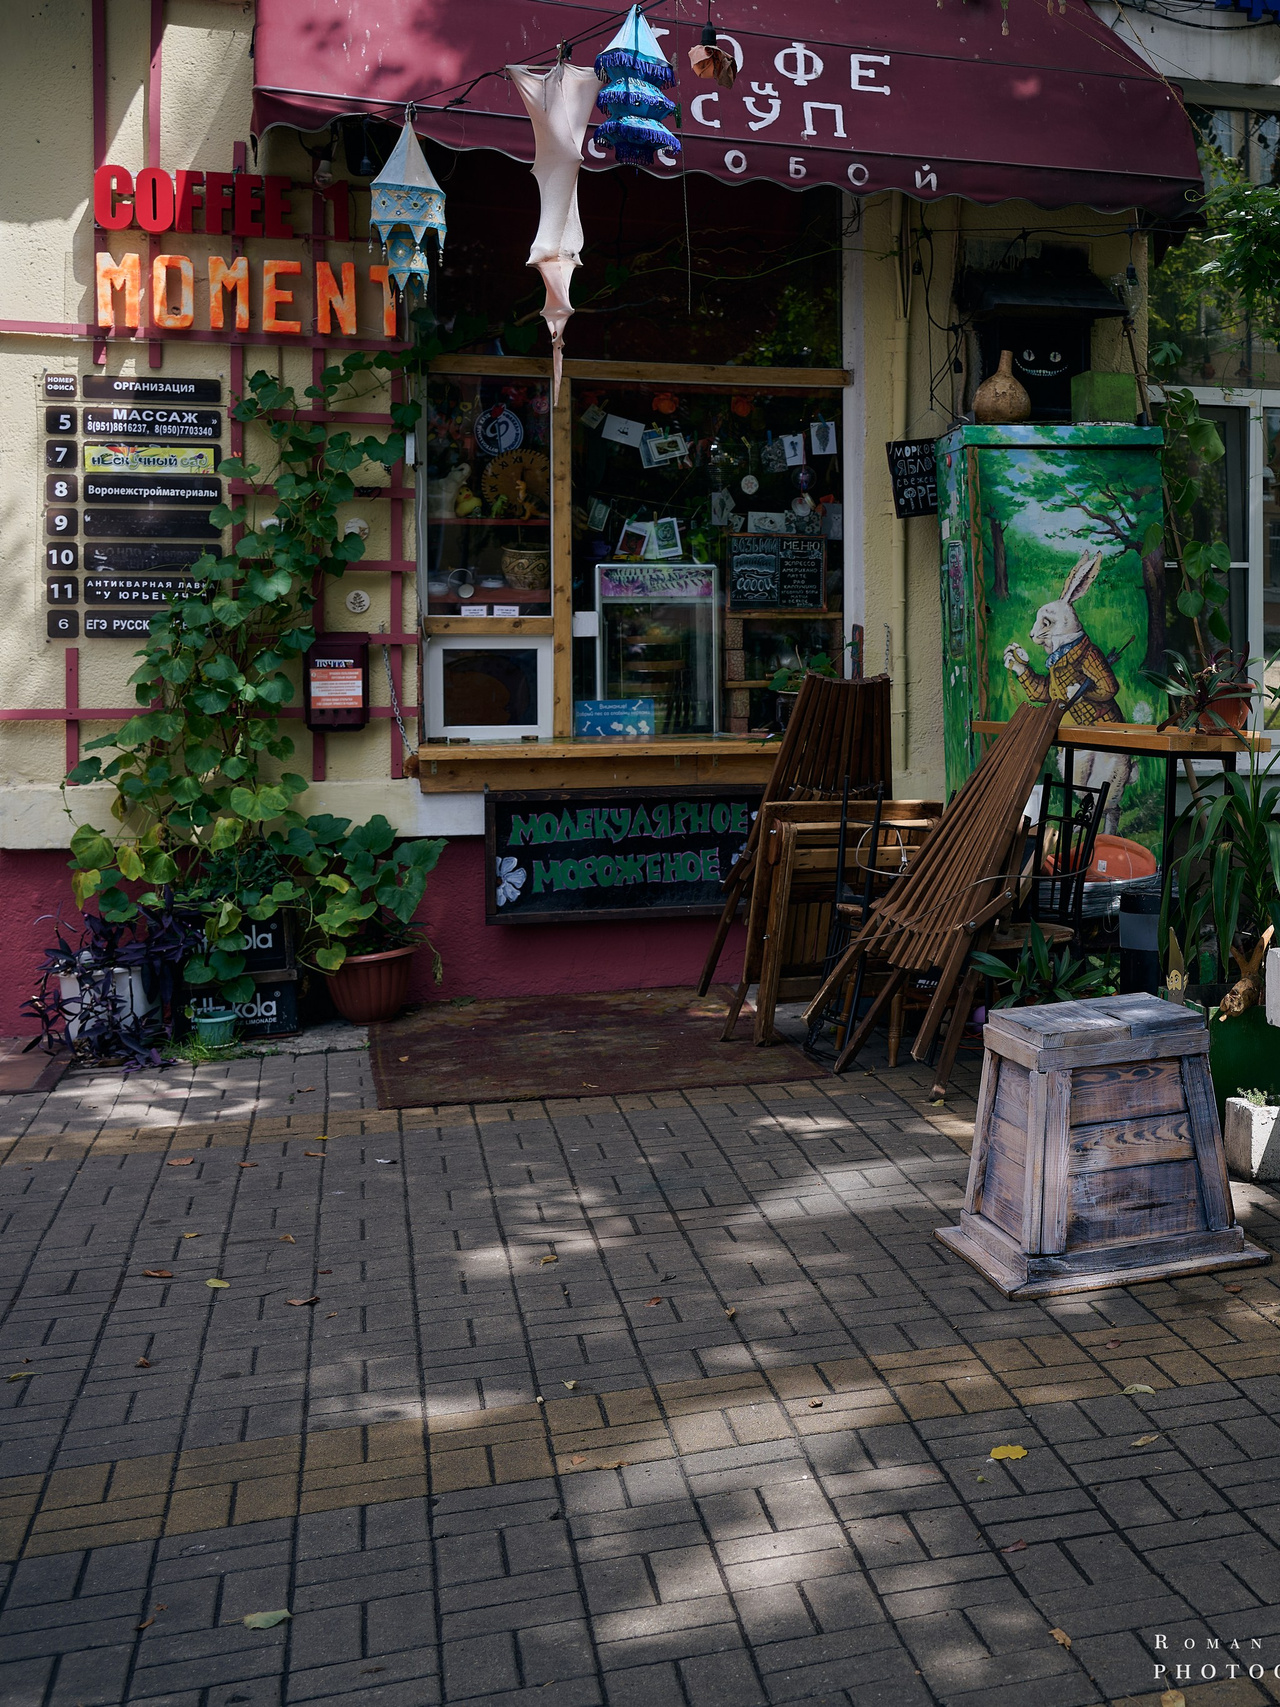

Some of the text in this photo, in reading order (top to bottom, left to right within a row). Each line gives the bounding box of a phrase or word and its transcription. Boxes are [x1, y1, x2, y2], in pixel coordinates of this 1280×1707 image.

[94, 165, 294, 239] COFFEE
[96, 252, 398, 338] MOMENT
[47, 376, 75, 384] НОМЕР
[113, 381, 196, 394] ОРГАНИЗАЦИЯ
[59, 414, 72, 431] 5
[112, 409, 199, 424] МАССАЖ
[87, 421, 213, 437] 8(951)8616237, 8(950)7703340
[55, 447, 68, 463] 7
[54, 481, 68, 498] 8
[88, 484, 219, 498] Воронежстройматериалы
[54, 515, 69, 531] 9
[783, 541, 821, 551] МЕНЮ
[48, 549, 75, 565] 10
[50, 583, 74, 599] 11
[87, 580, 173, 589] АНТИКВАРНАЯ
[58, 618, 70, 630] 6
[86, 619, 108, 630] ЕГЭ
[315, 659, 346, 668] ПОЧТА
[508, 801, 748, 846] МОЛЕКУЛЯРНОЕ
[531, 847, 720, 895] МОРОЖЕНОЕ
[245, 1017, 278, 1026] LIMONADE
